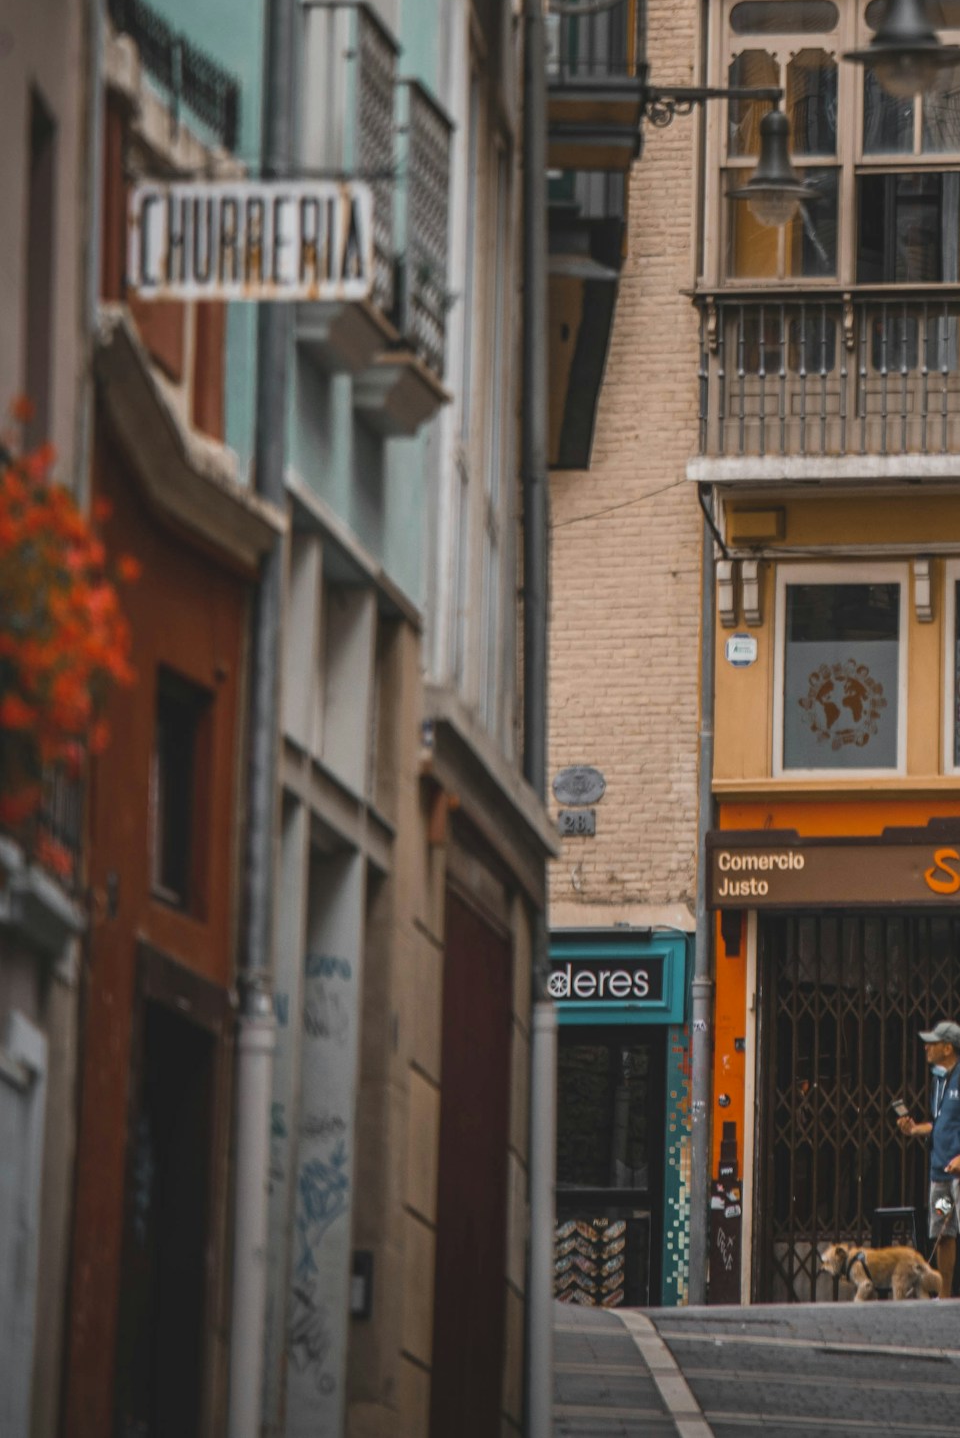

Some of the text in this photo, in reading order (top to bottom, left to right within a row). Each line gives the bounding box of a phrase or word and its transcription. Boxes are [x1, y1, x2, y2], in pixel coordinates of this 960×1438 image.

[139, 195, 367, 286] CHURRERIA
[718, 851, 805, 872] Comercio
[718, 876, 769, 897] Justo
